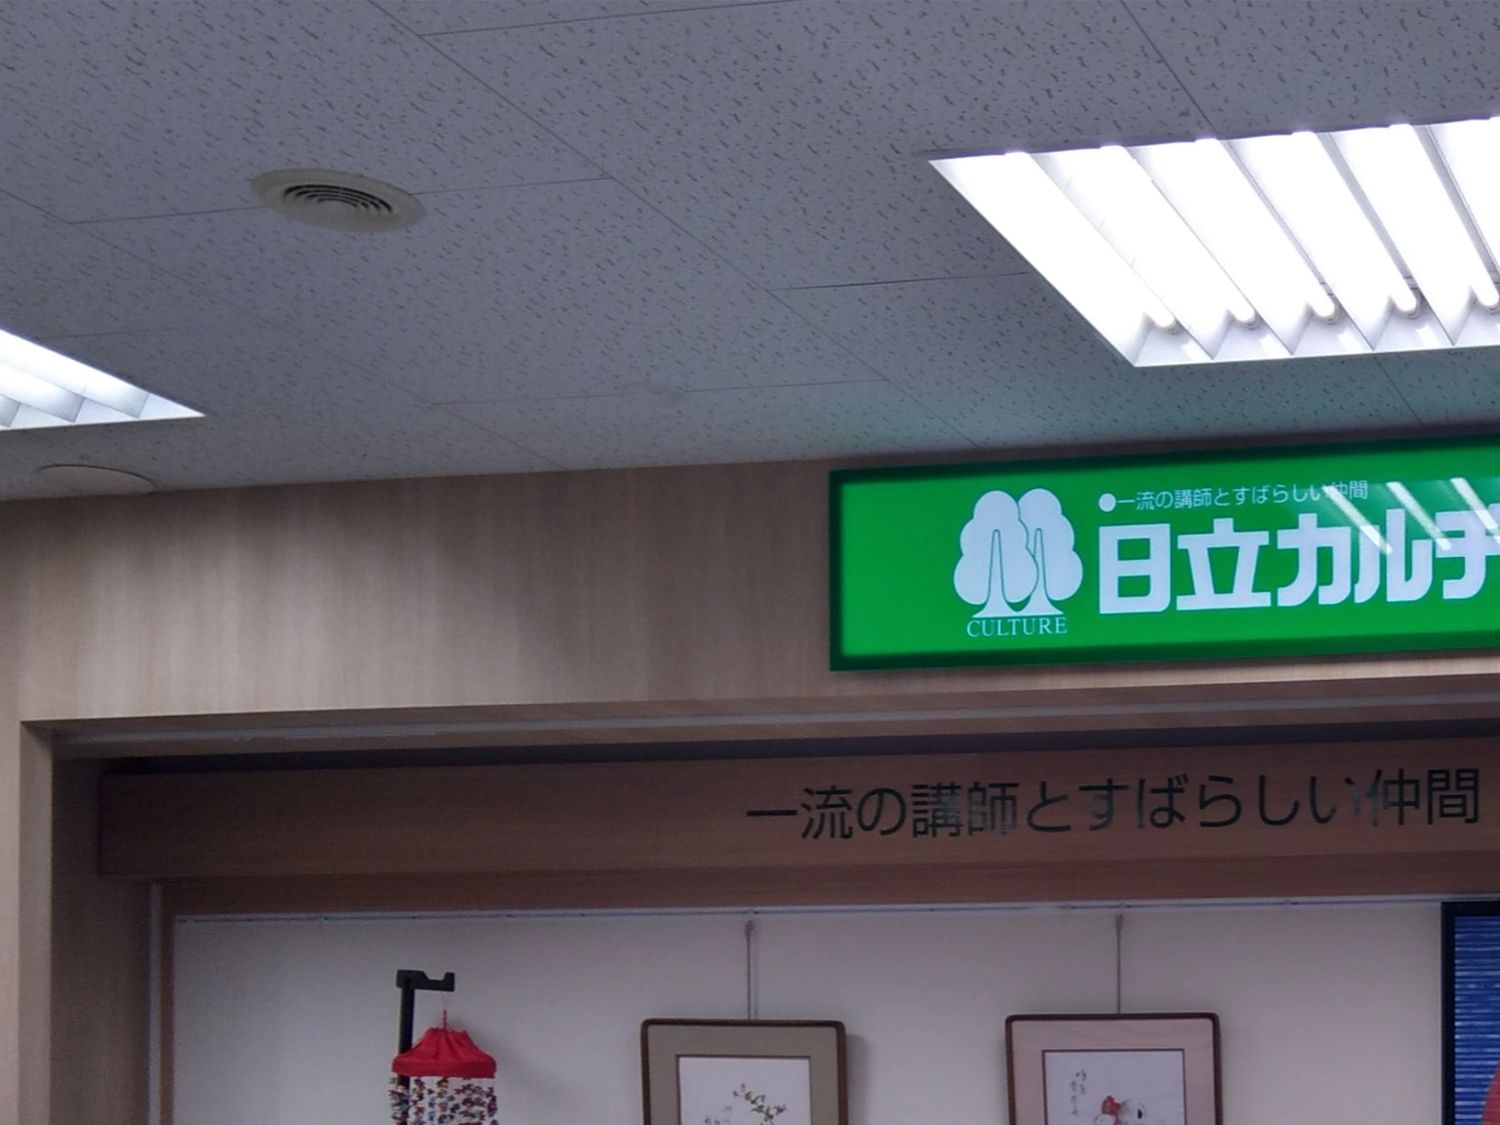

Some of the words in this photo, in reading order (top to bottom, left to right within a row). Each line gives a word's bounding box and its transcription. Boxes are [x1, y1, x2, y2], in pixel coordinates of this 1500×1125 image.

[966, 616, 1068, 638] CULTURE
[746, 766, 1481, 840] 一流の講師とすばらしい仲間
